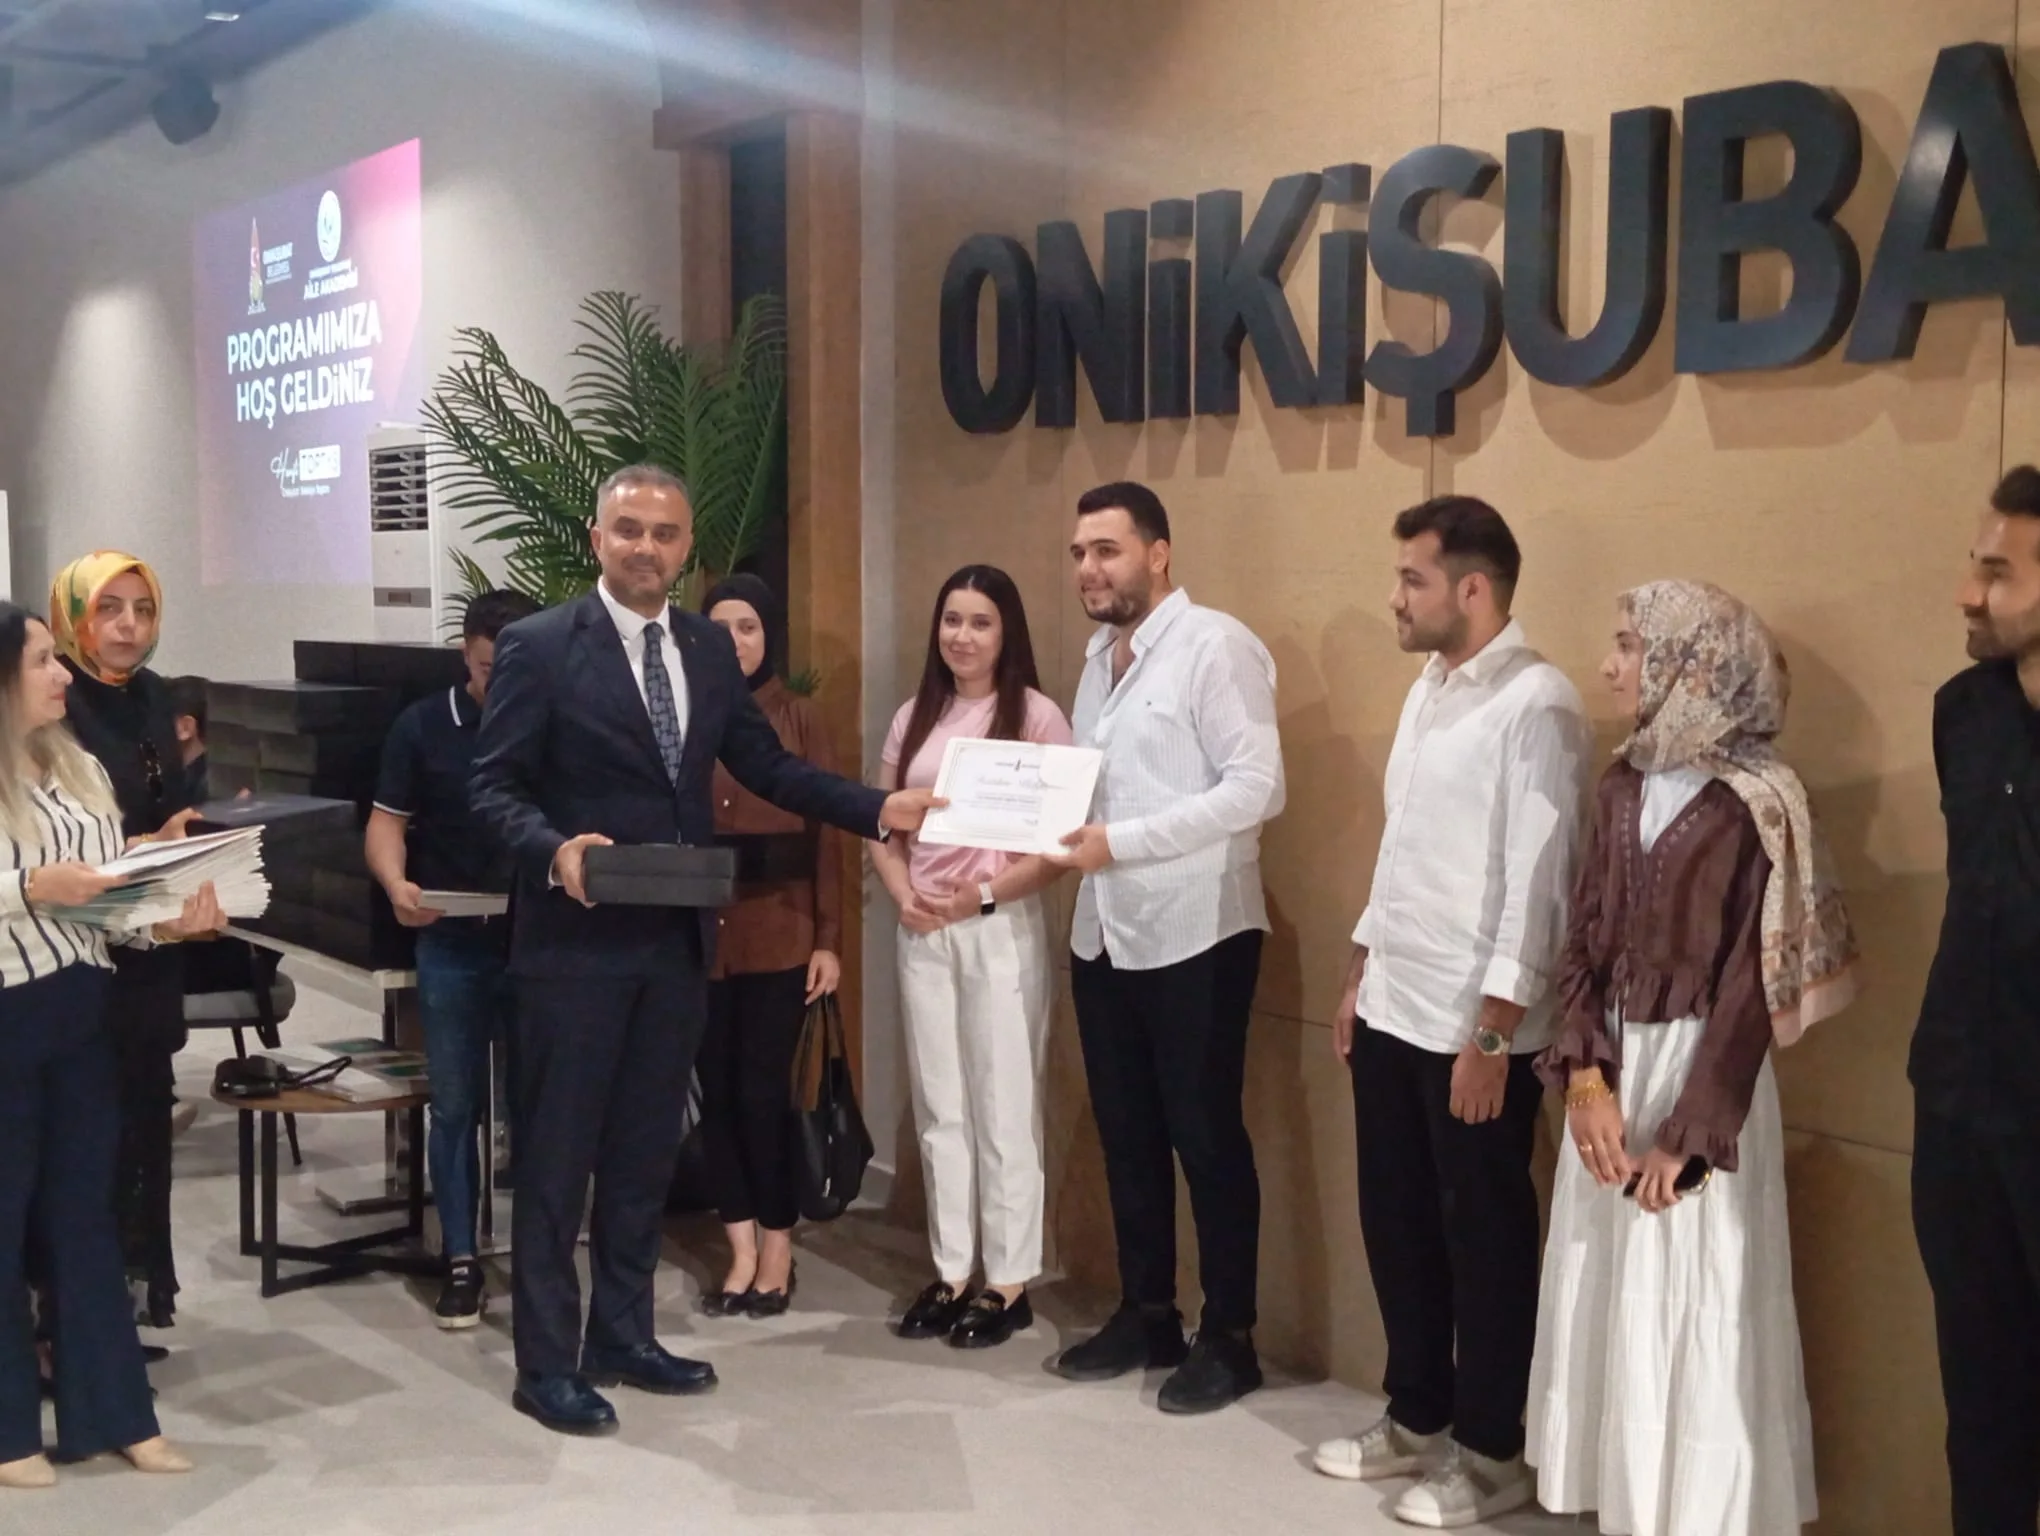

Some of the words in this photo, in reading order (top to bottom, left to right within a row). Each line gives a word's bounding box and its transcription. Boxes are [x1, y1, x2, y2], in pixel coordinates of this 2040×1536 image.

[227, 299, 382, 375] PROGRAMIMIZA
[236, 376, 277, 430] HOŞ
[280, 356, 374, 415] GELDİNİZ
